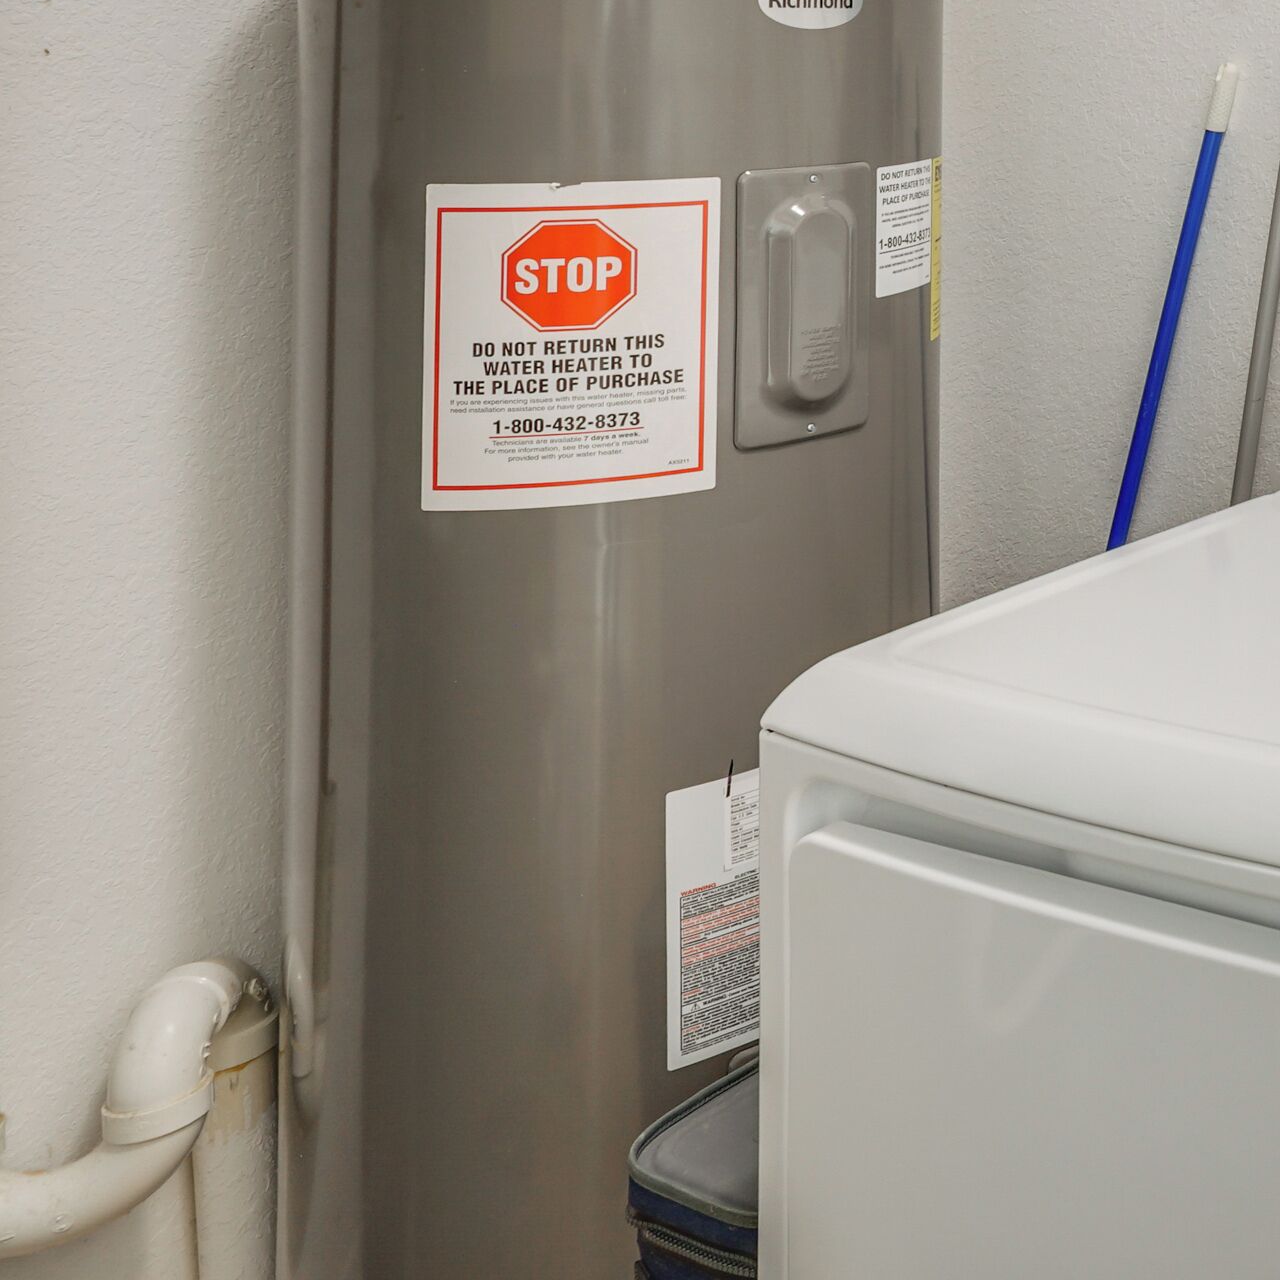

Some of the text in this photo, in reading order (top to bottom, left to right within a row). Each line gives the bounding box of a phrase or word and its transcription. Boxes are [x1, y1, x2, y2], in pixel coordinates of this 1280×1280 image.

[892, 170, 904, 179] NOT
[879, 184, 899, 193] WATER
[882, 196, 900, 206] PLACE
[515, 256, 623, 295] STOP
[472, 333, 665, 357] DO NOT RETURN THIS
[483, 353, 652, 376] WATER HEATER TO
[453, 369, 684, 395] THE PLACE OF PURCHASE
[483, 398, 528, 406] experiencing
[636, 388, 665, 396] missing
[576, 401, 605, 410] general
[606, 398, 642, 408] questions
[492, 411, 640, 434] 1-800-432-8373
[549, 435, 582, 443] available
[590, 433, 610, 441] days
[508, 454, 539, 462] provided
[680, 882, 717, 897] WARNING
